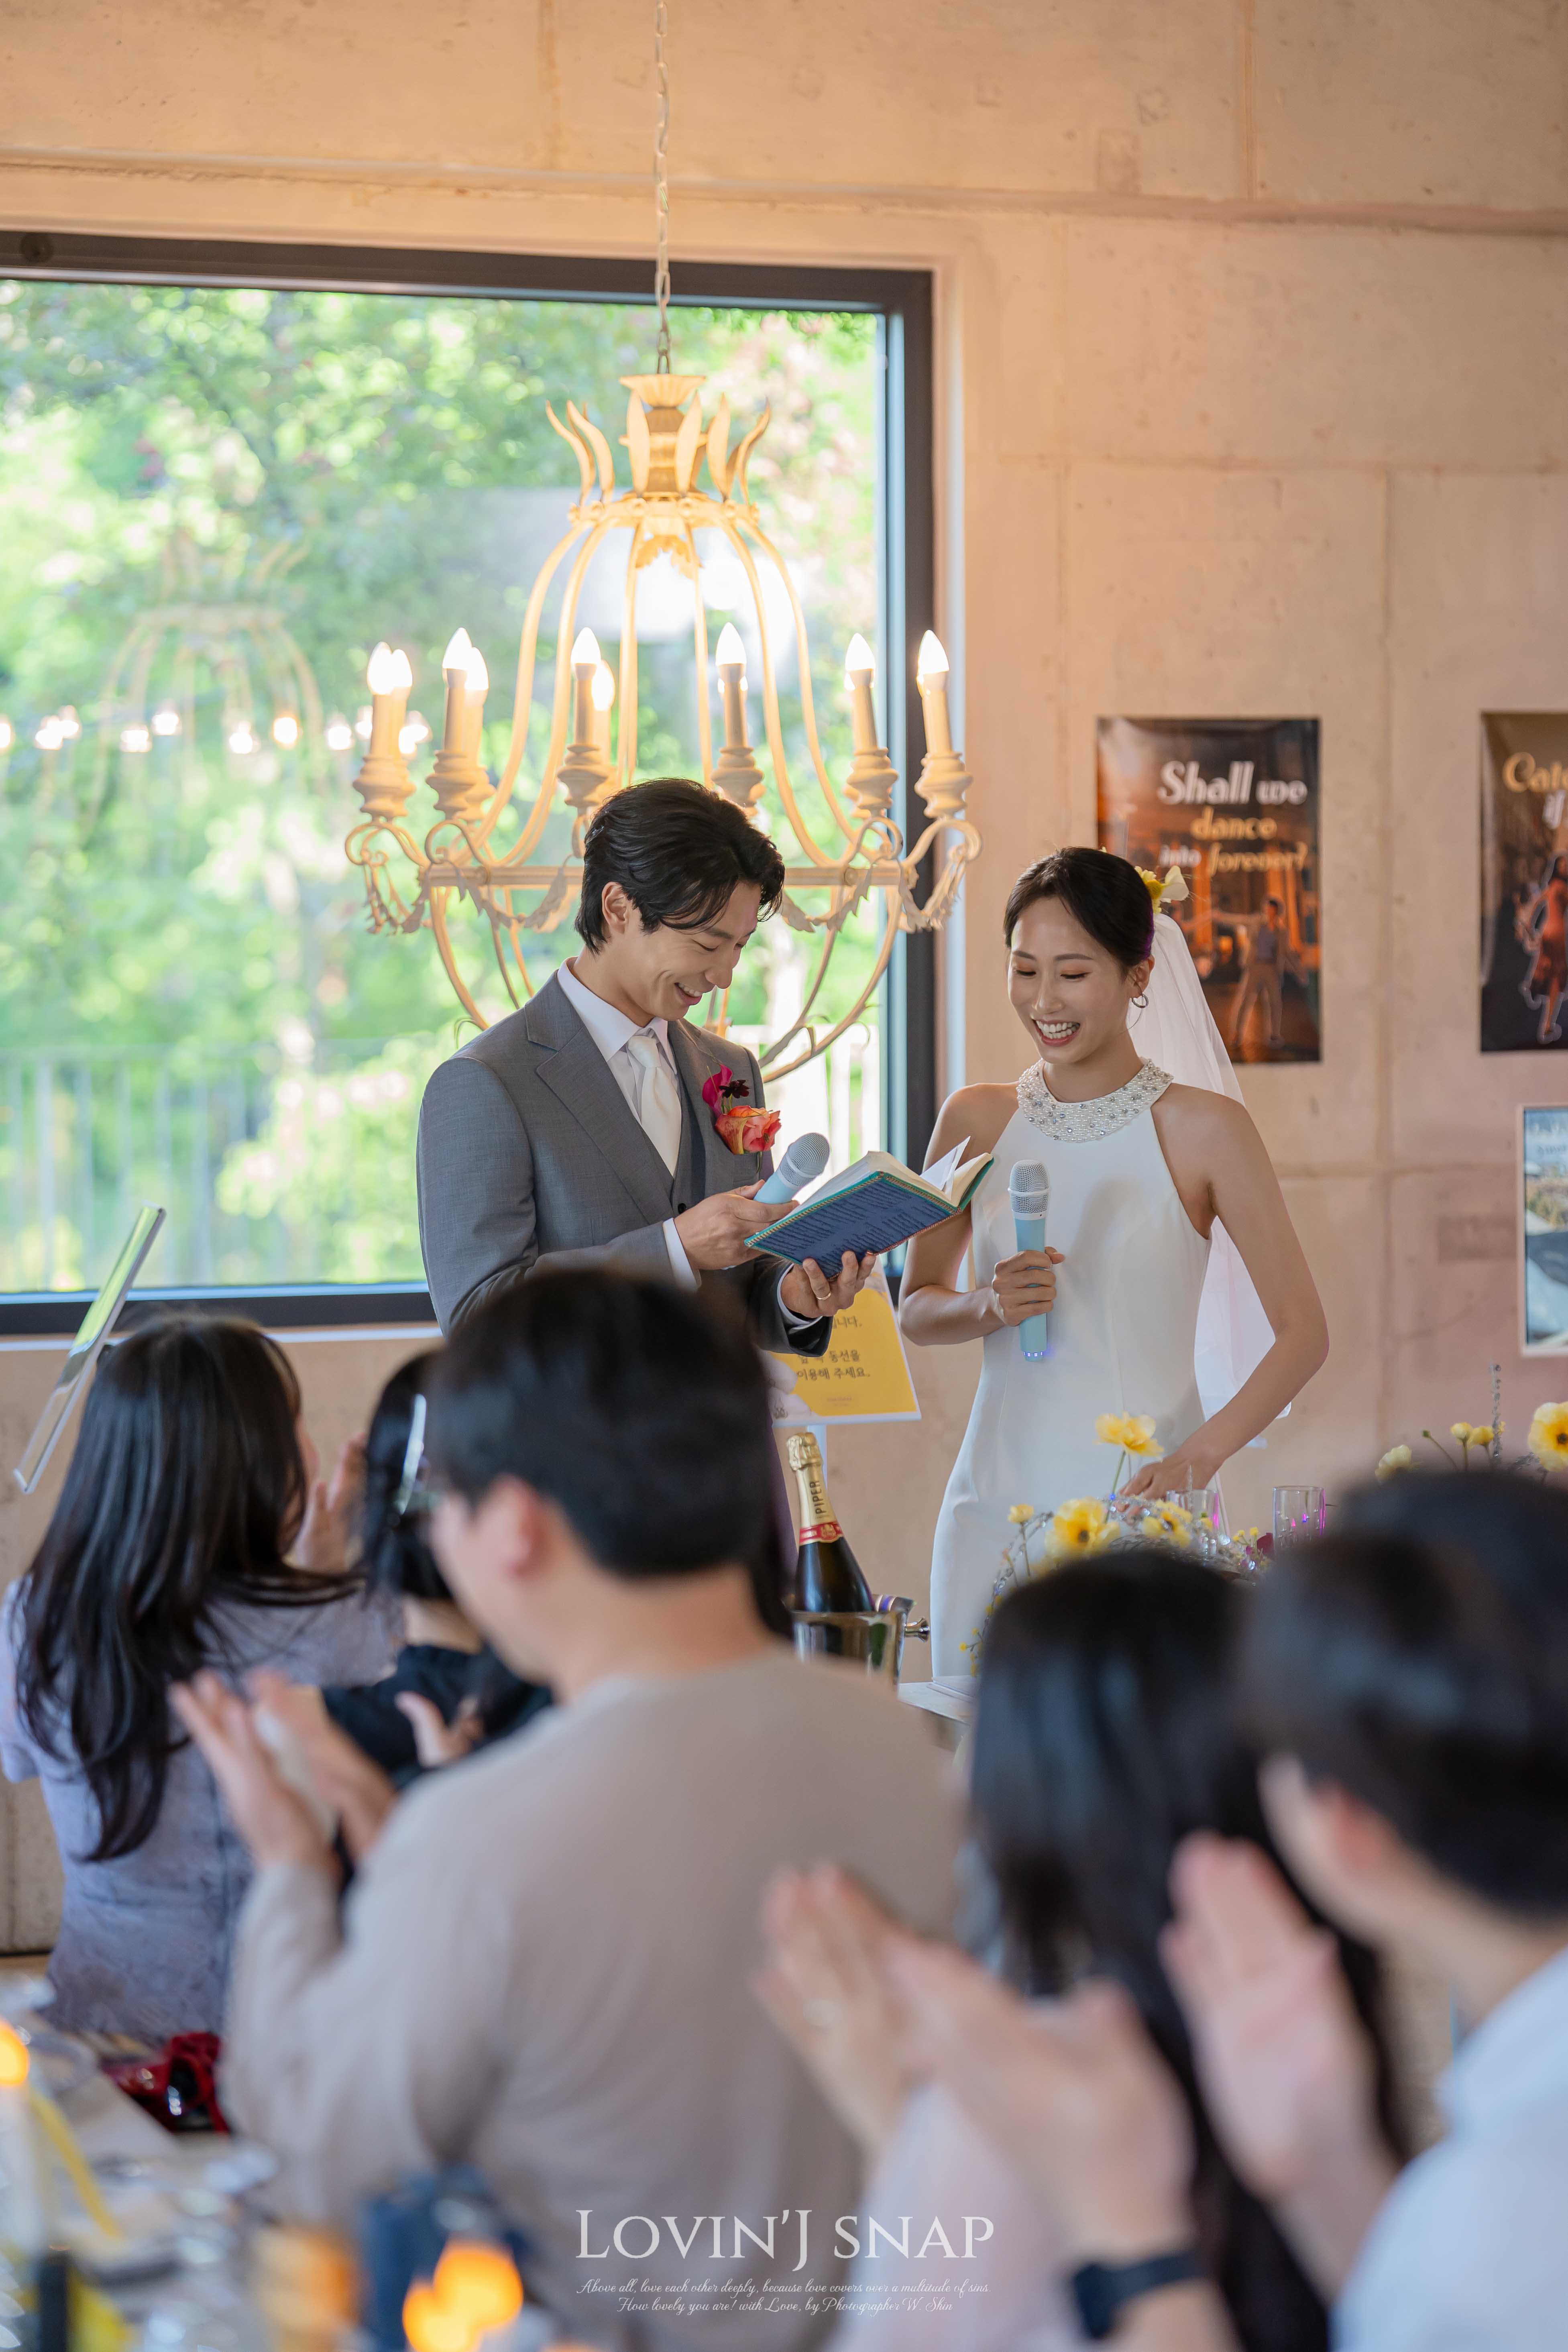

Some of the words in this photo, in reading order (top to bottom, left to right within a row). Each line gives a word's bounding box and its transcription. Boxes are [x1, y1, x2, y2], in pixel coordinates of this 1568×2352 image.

[1157, 760, 1254, 805] Shall
[1256, 780, 1308, 805] we
[1190, 806, 1277, 840] dance
[1159, 844, 1201, 867] into
[829, 1350, 860, 1362] 동선을
[797, 1368, 830, 1381] 이용해
[834, 1366, 870, 1379] 주세요.
[809, 1481, 826, 1514] PIPER
